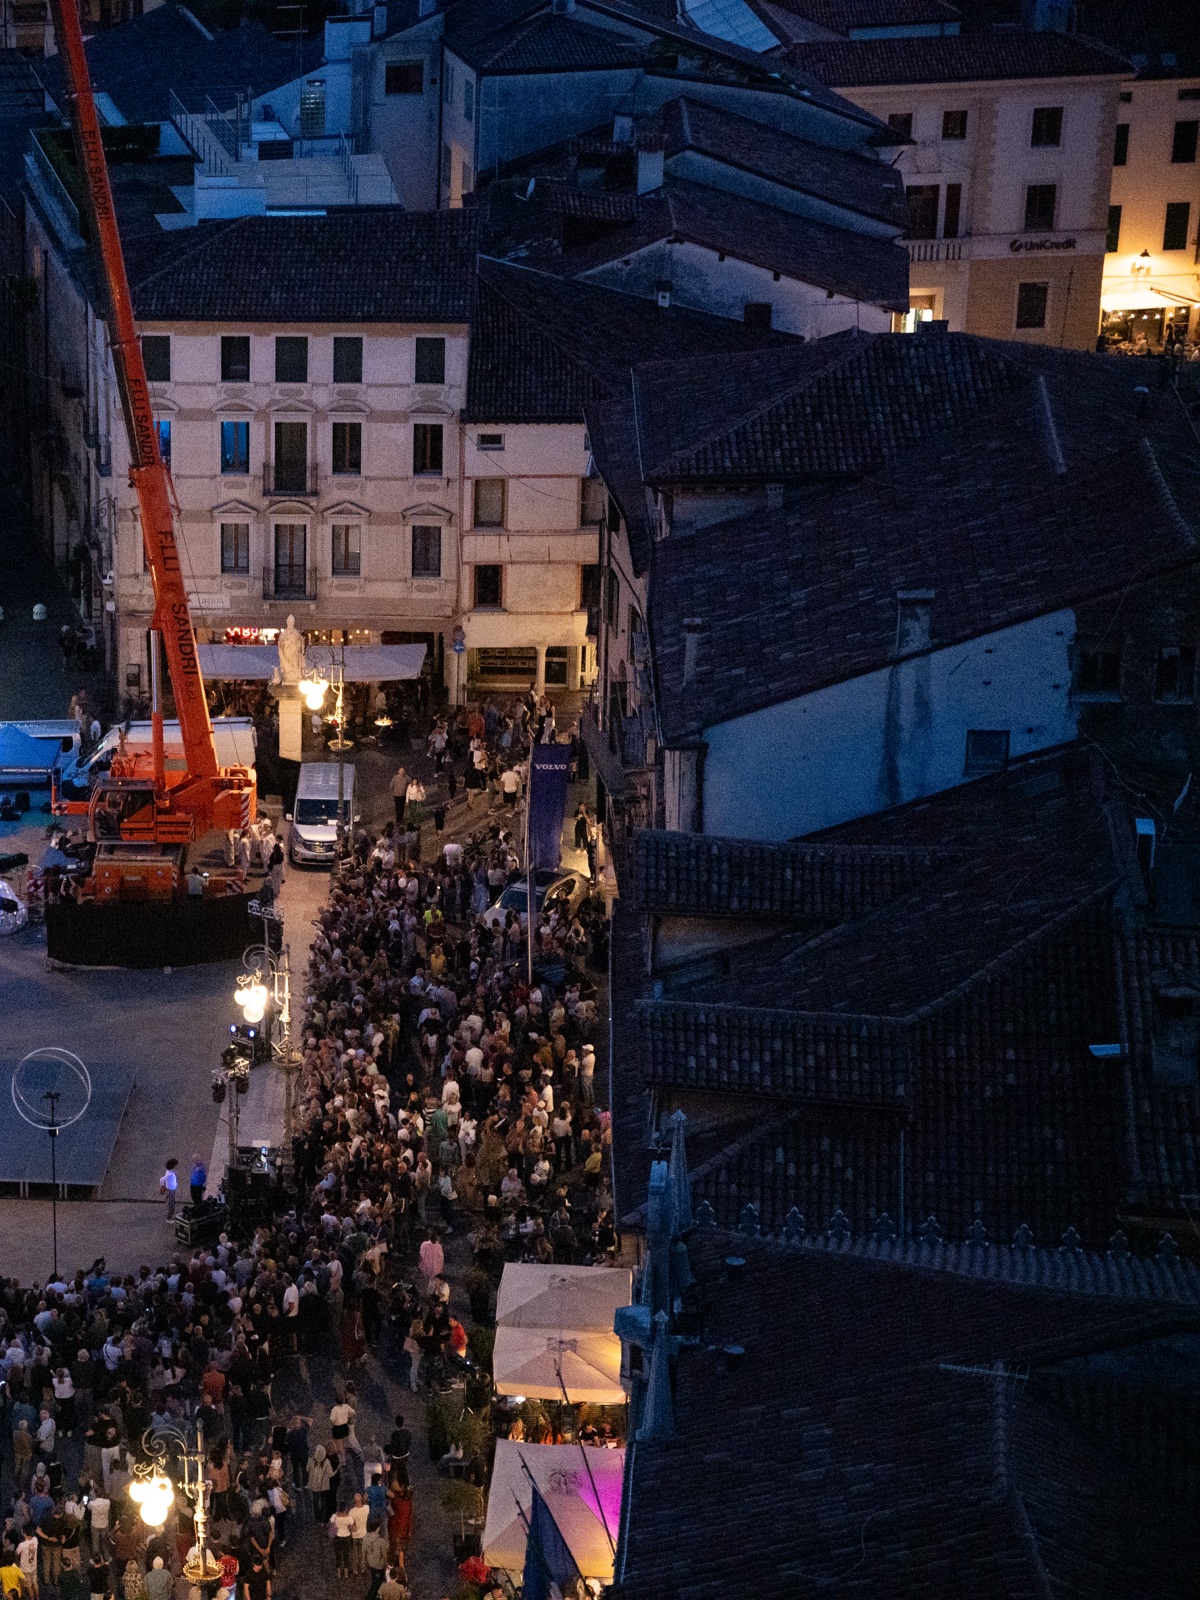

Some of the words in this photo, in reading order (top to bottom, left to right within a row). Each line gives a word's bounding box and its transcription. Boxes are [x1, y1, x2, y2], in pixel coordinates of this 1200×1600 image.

[90, 167, 111, 220] SANDRI
[1025, 238, 1076, 250] UniCredit
[135, 415, 155, 466] SANDR
[172, 603, 198, 675] SANDRI
